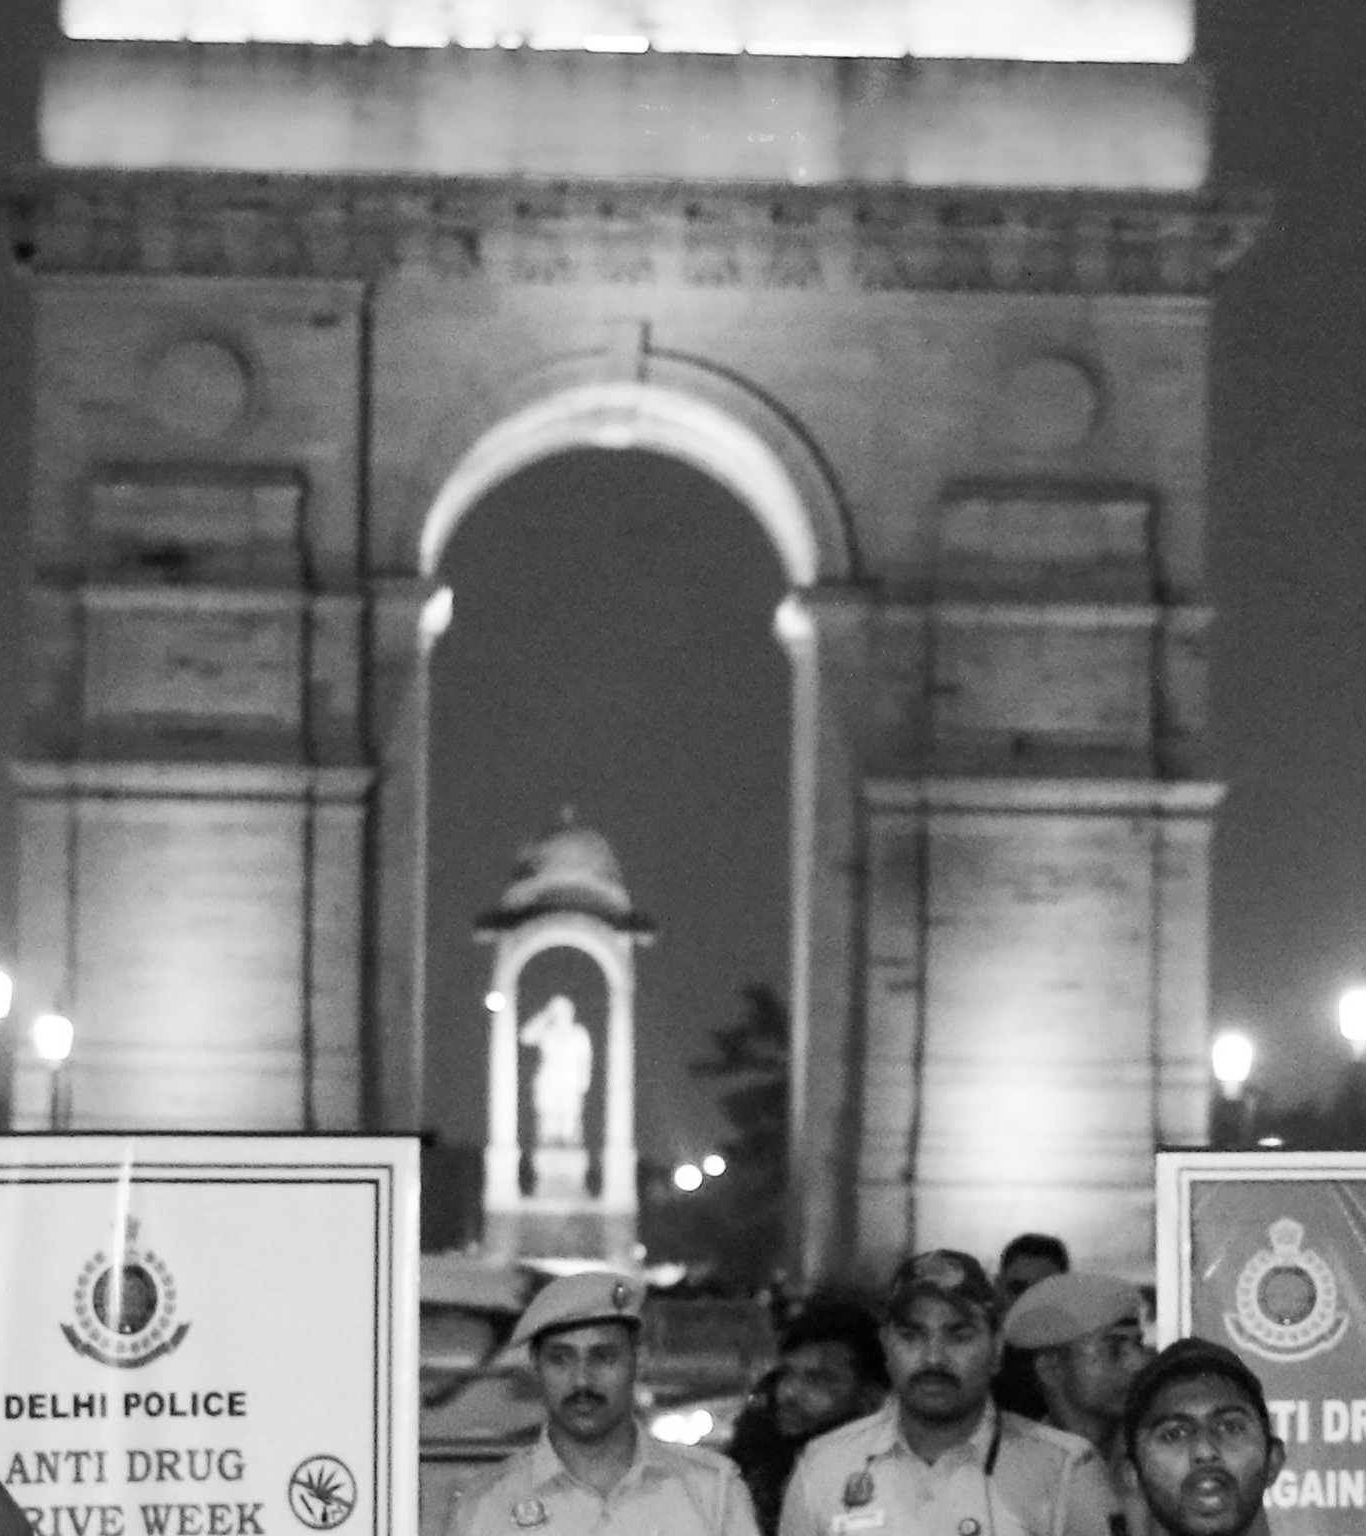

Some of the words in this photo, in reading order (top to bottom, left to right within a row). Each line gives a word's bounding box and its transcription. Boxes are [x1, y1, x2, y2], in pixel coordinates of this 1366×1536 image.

[3, 1393, 108, 1419] DELHI
[123, 1391, 248, 1418] POLICE
[1267, 1399, 1311, 1443] TI
[5, 1449, 108, 1485] ANTI
[126, 1447, 247, 1483] DRUG
[139, 1502, 266, 1536] WEEK
